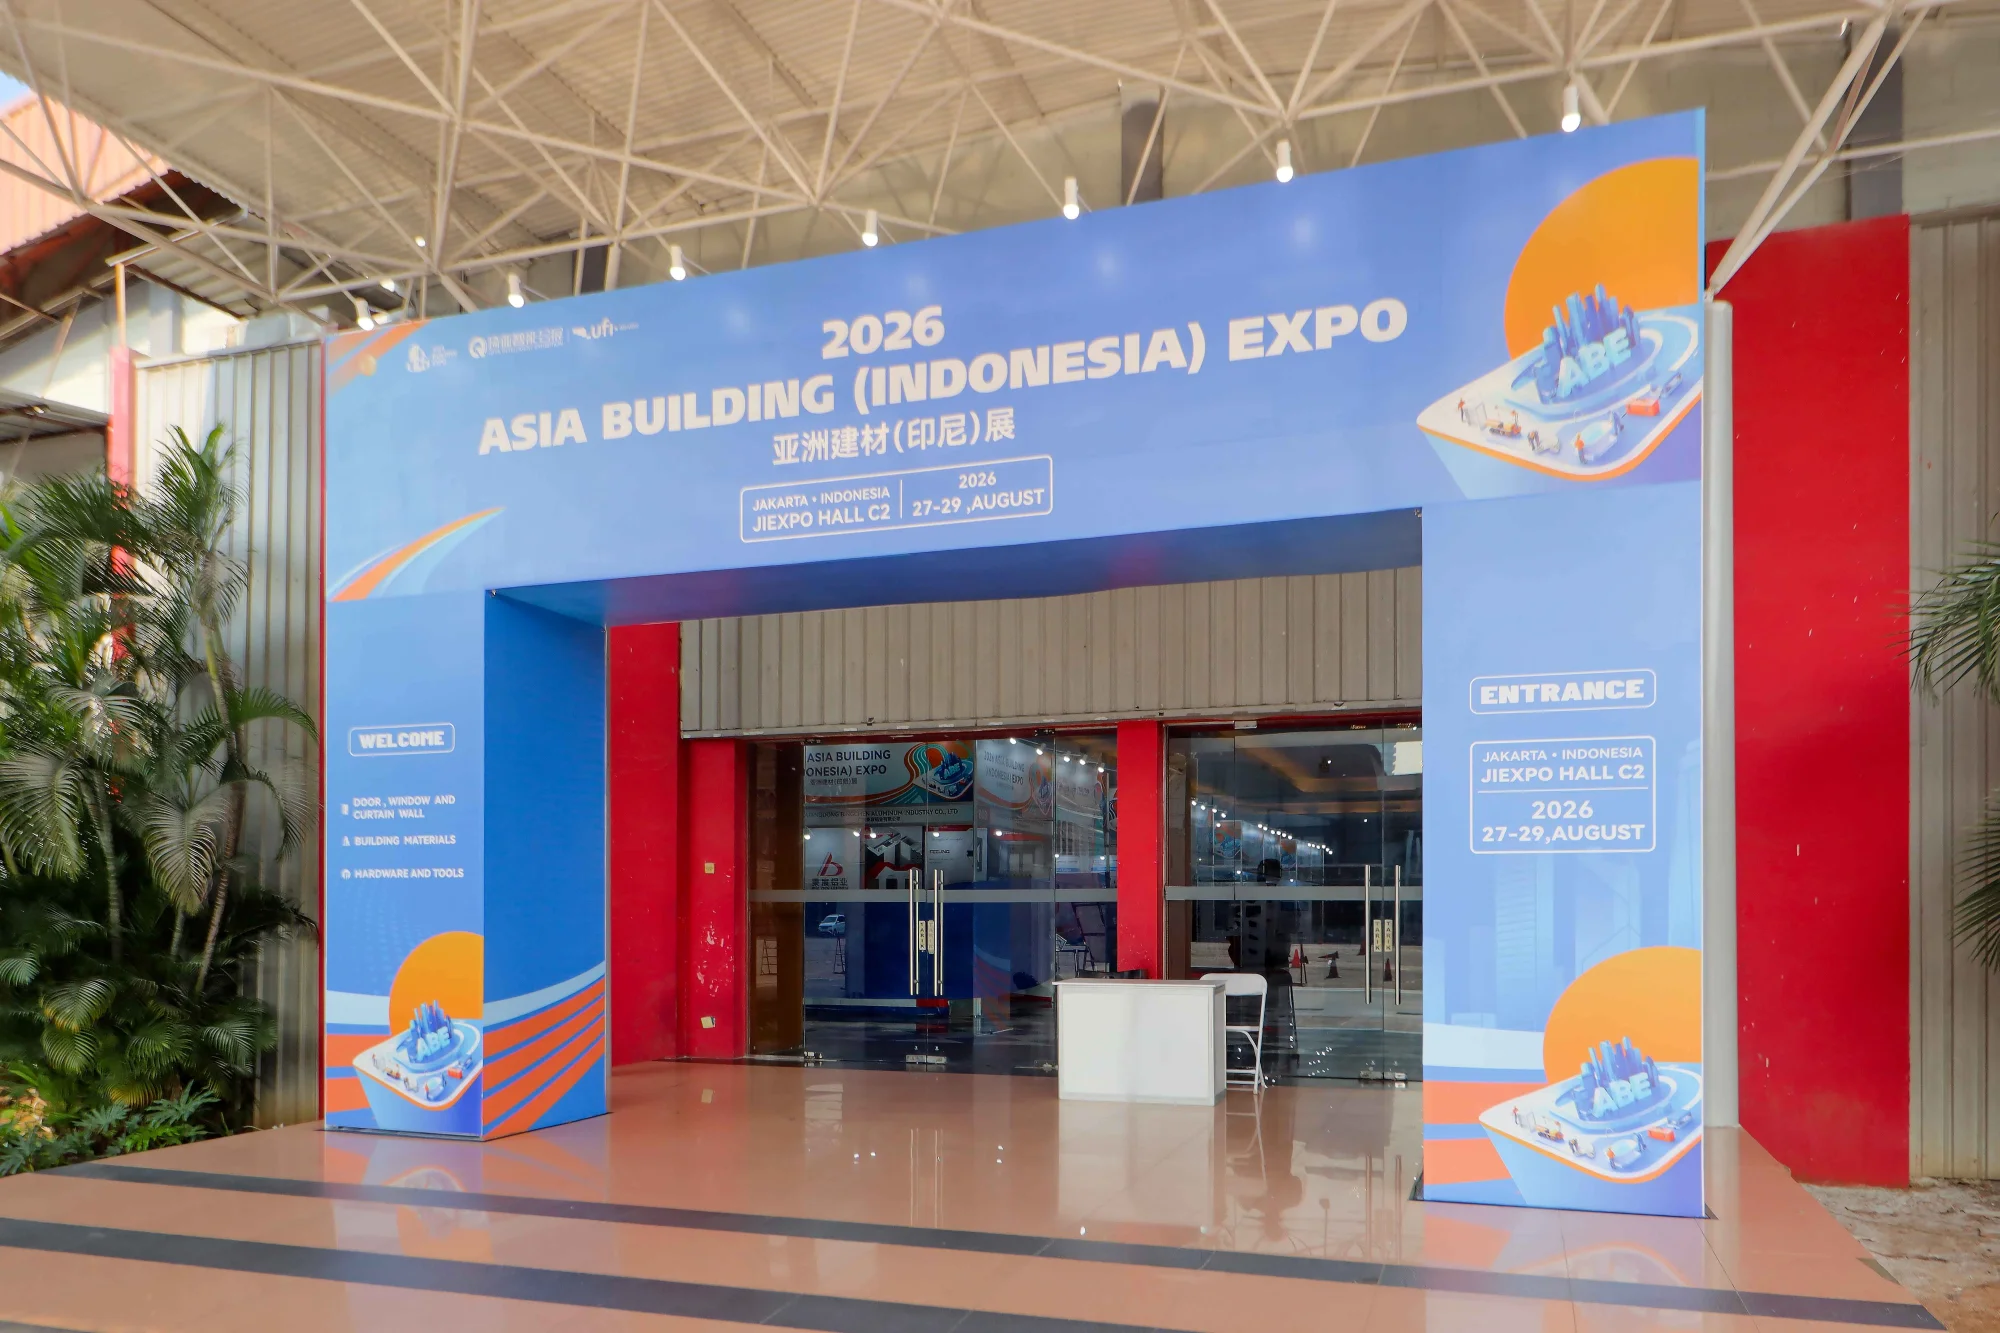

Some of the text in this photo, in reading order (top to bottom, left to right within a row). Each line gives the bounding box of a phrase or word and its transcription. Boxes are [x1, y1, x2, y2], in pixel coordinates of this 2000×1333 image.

[822, 305, 945, 360] 2026
[1557, 327, 1631, 398] ABE
[478, 297, 1407, 455] ASIA BUILDING (INDONESIA) EXPO
[772, 407, 1015, 466] 亚洲建材(印尼)展
[958, 470, 997, 489] 2026
[753, 485, 890, 511] JAKARTA INDONESIA
[912, 495, 961, 518] 27-29
[752, 503, 891, 533] JIEXPO HALL C2
[1480, 678, 1645, 705] ENTRANCE
[358, 730, 445, 749] WELCOME
[807, 749, 891, 763] ASIA BUILDING
[1482, 746, 1642, 763] JAKARTA INDONESIA
[805, 764, 887, 777] ONESIA) EXPO
[1481, 764, 1645, 783] JIEXPO HALL C2
[388, 795, 431, 806] WINDOW
[434, 794, 456, 805] AND
[1531, 799, 1593, 820] 2026
[352, 808, 425, 820] CURTAIN WALL
[354, 834, 457, 846] BUILDING MATERIALS
[354, 867, 464, 879] HARDWARE AND TOOLS
[416, 1026, 451, 1062] ABE
[1592, 1072, 1652, 1119] ABE
